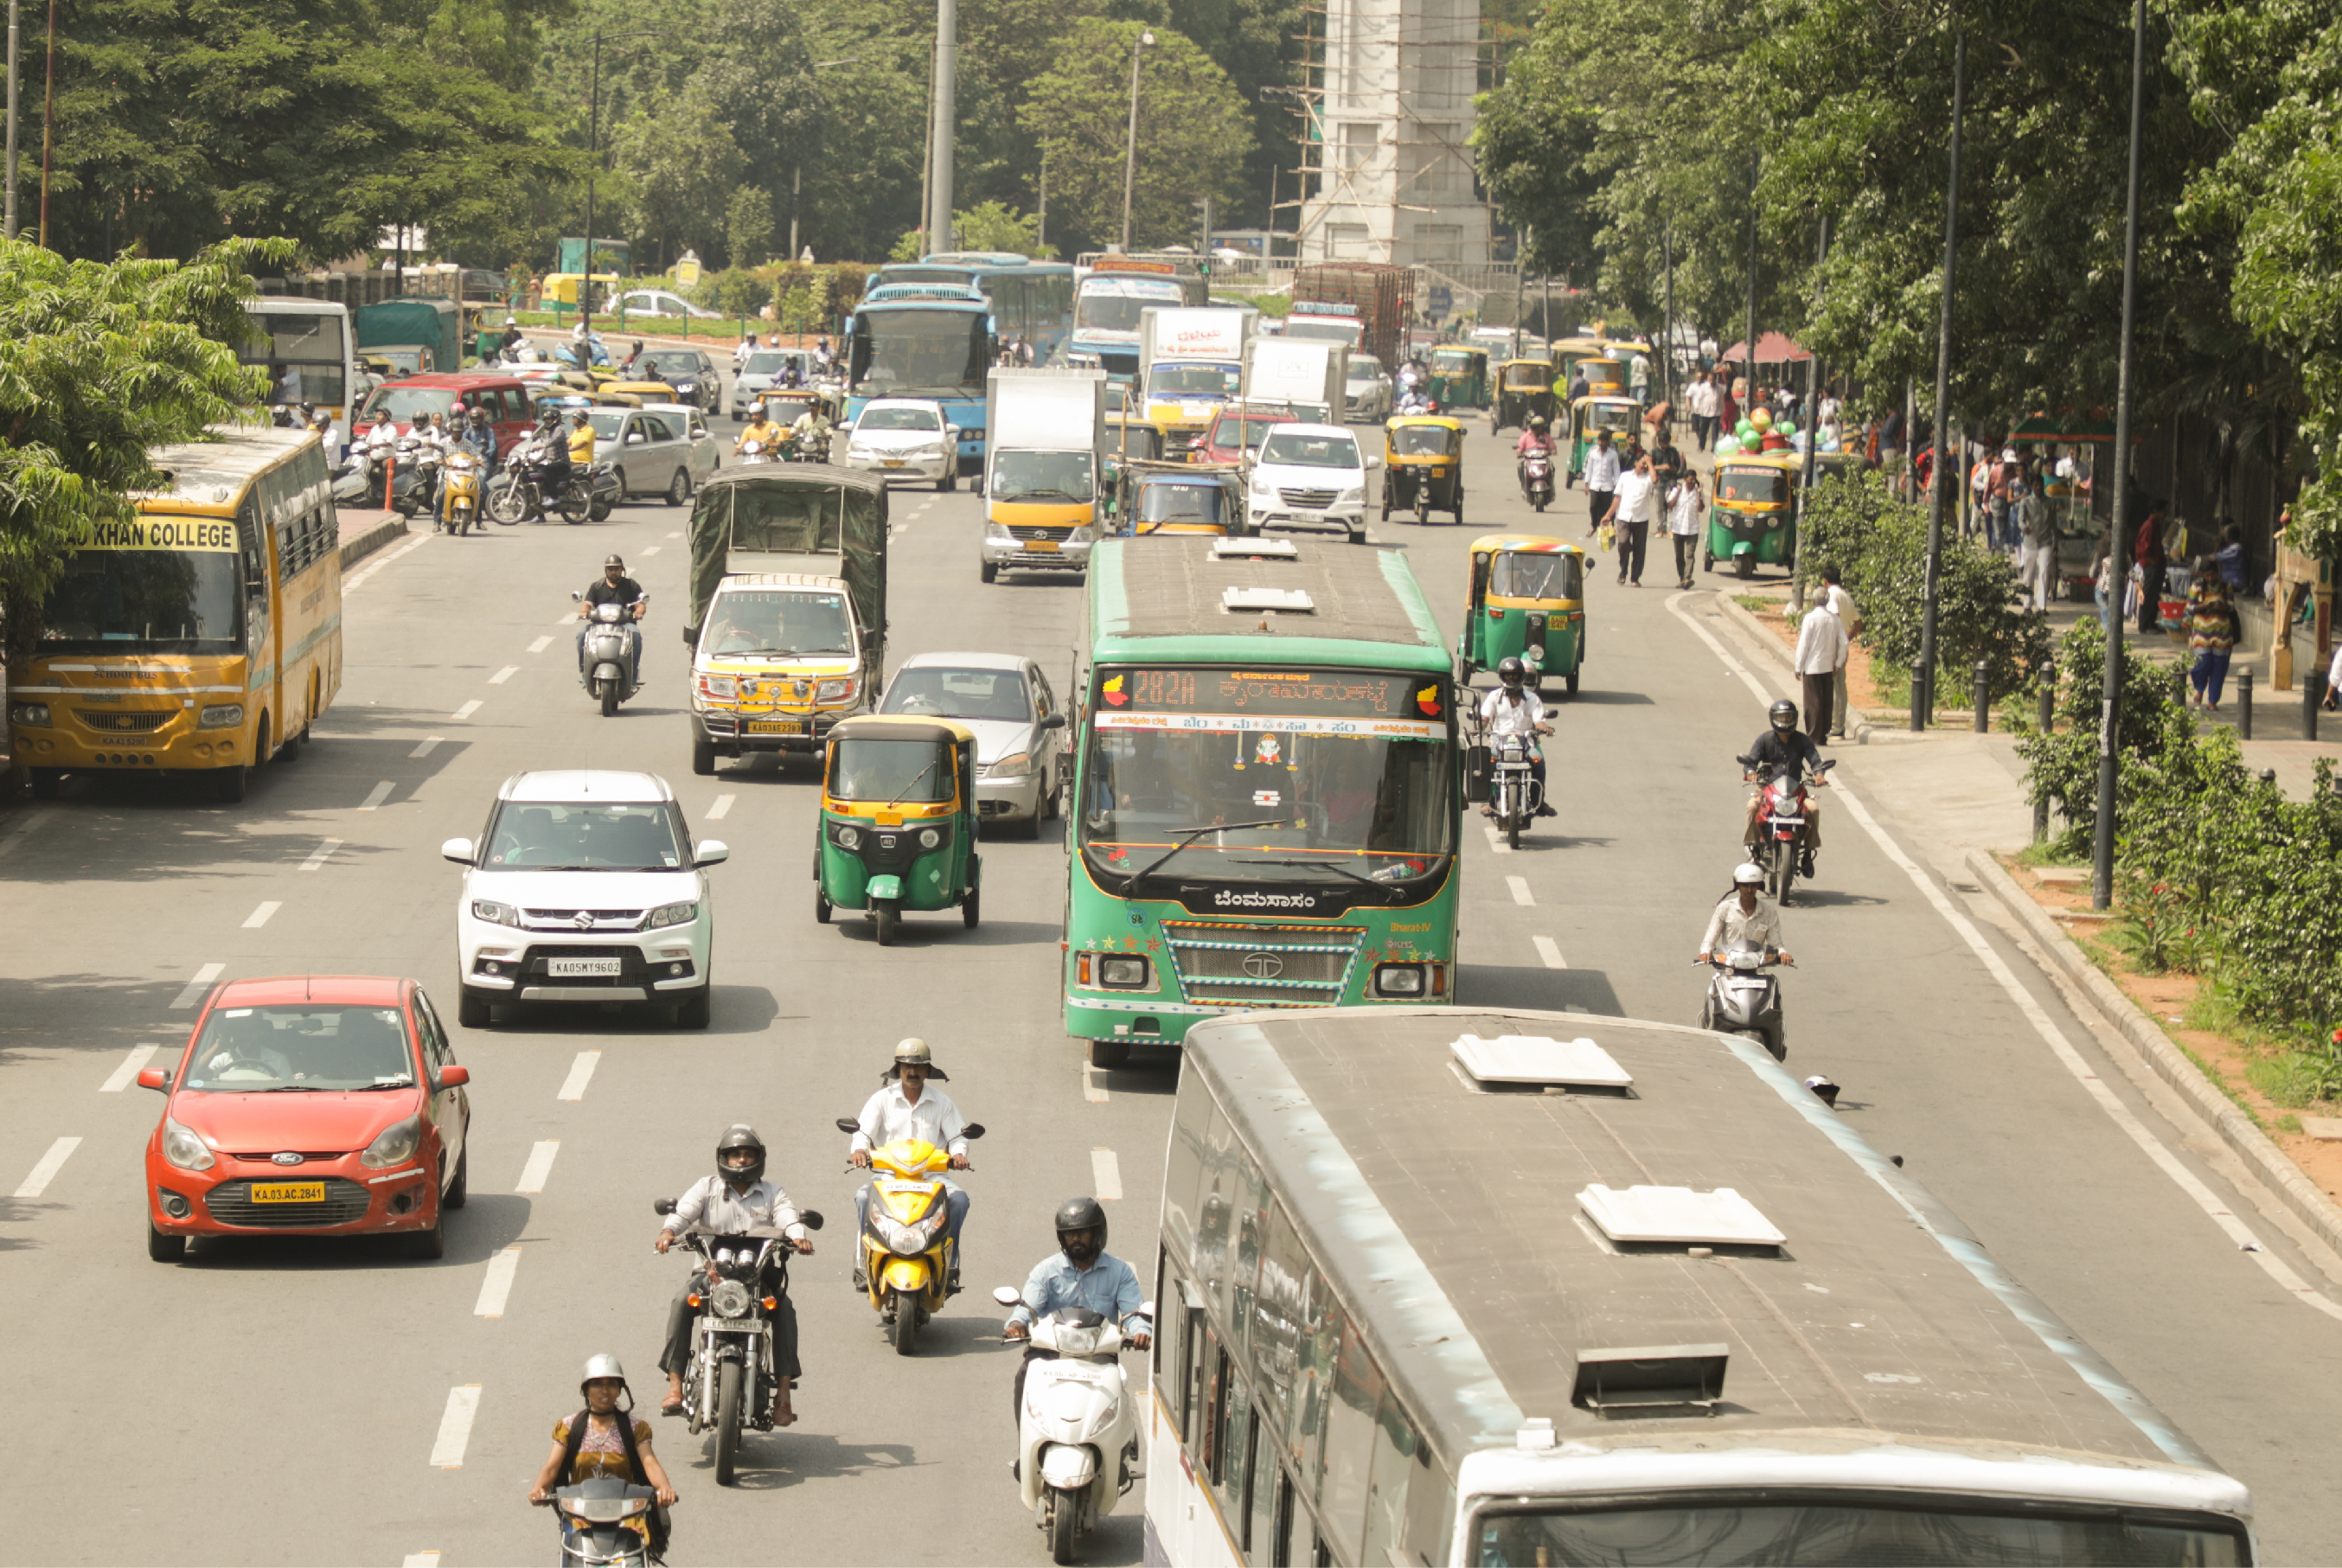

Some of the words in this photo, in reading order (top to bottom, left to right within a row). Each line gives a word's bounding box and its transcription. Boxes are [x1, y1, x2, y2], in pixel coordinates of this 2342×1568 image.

[94, 523, 144, 547] KHAN
[150, 523, 232, 548] COLLEGE
[137, 671, 158, 680] BUS
[1135, 670, 1196, 705] 282A
[1214, 889, 1315, 907] ಬೆಂಮಸಾಸಂ
[556, 963, 620, 972] KA05MY9602
[254, 1187, 321, 1200] KA.03.AC.2841
